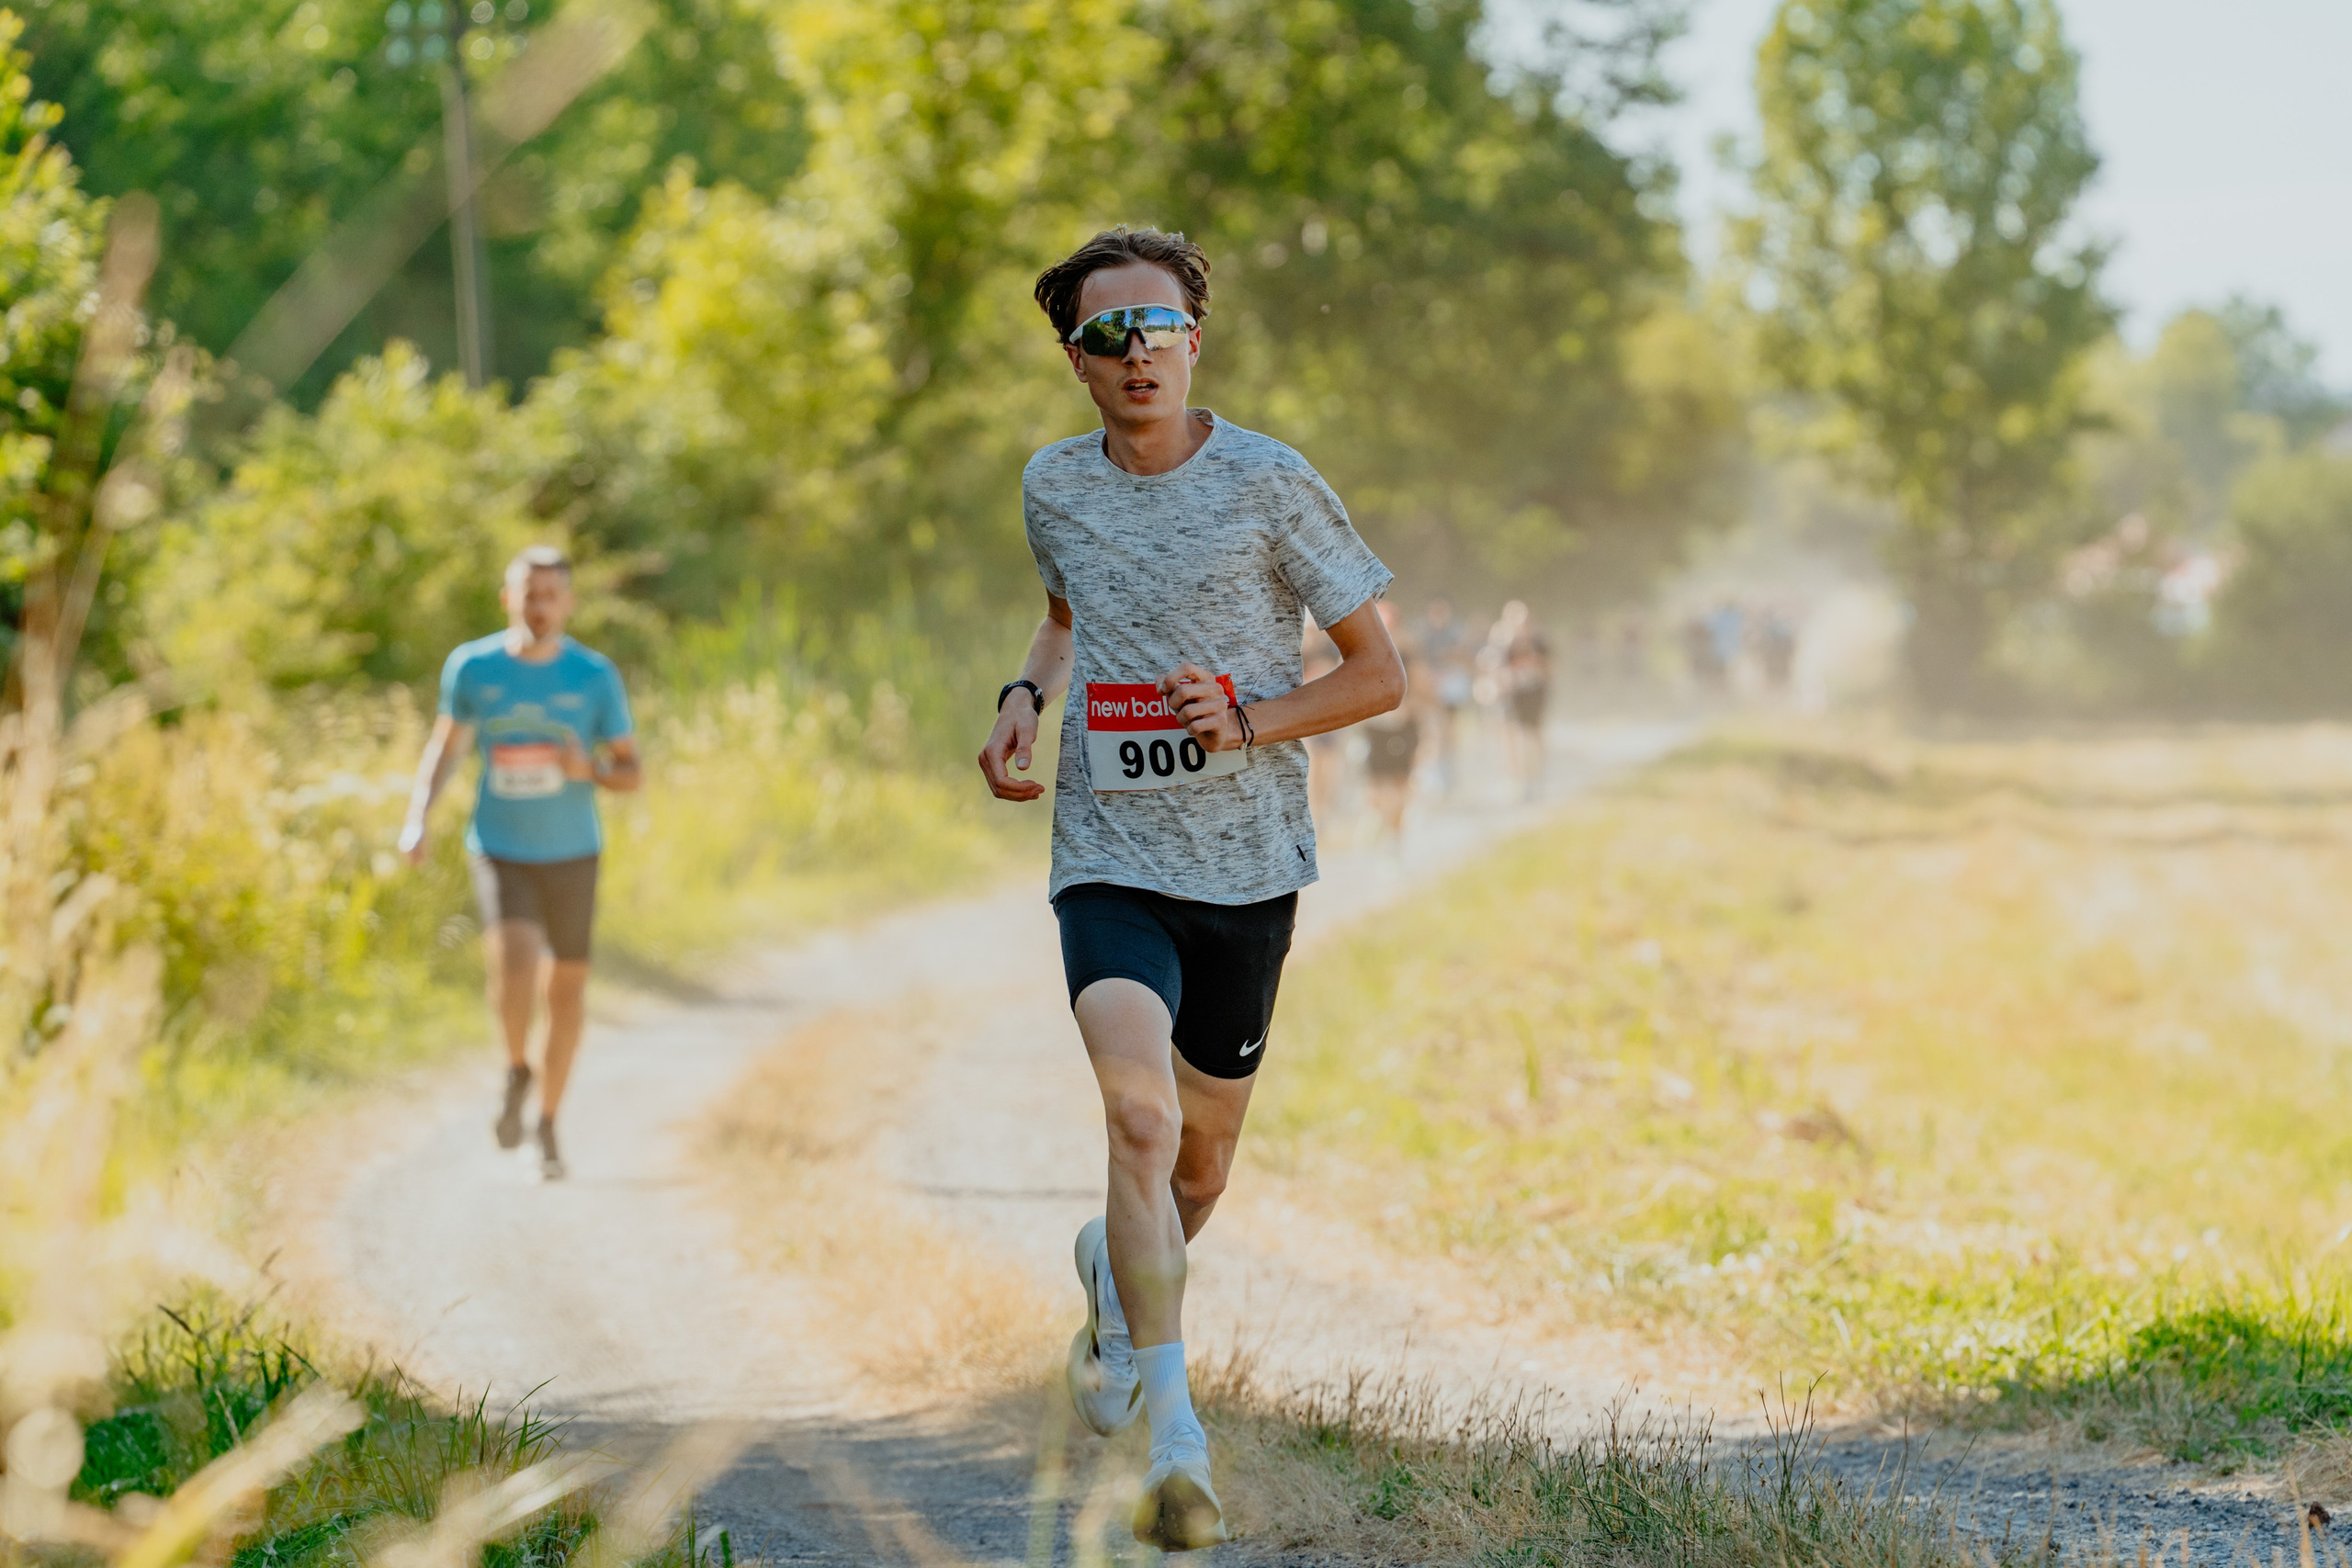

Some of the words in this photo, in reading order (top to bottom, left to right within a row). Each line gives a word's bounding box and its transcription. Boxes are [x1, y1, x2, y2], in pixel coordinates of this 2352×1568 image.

[1091, 700, 1128, 717] new
[1131, 695, 1178, 717] bal
[1119, 738, 1206, 779] 900
